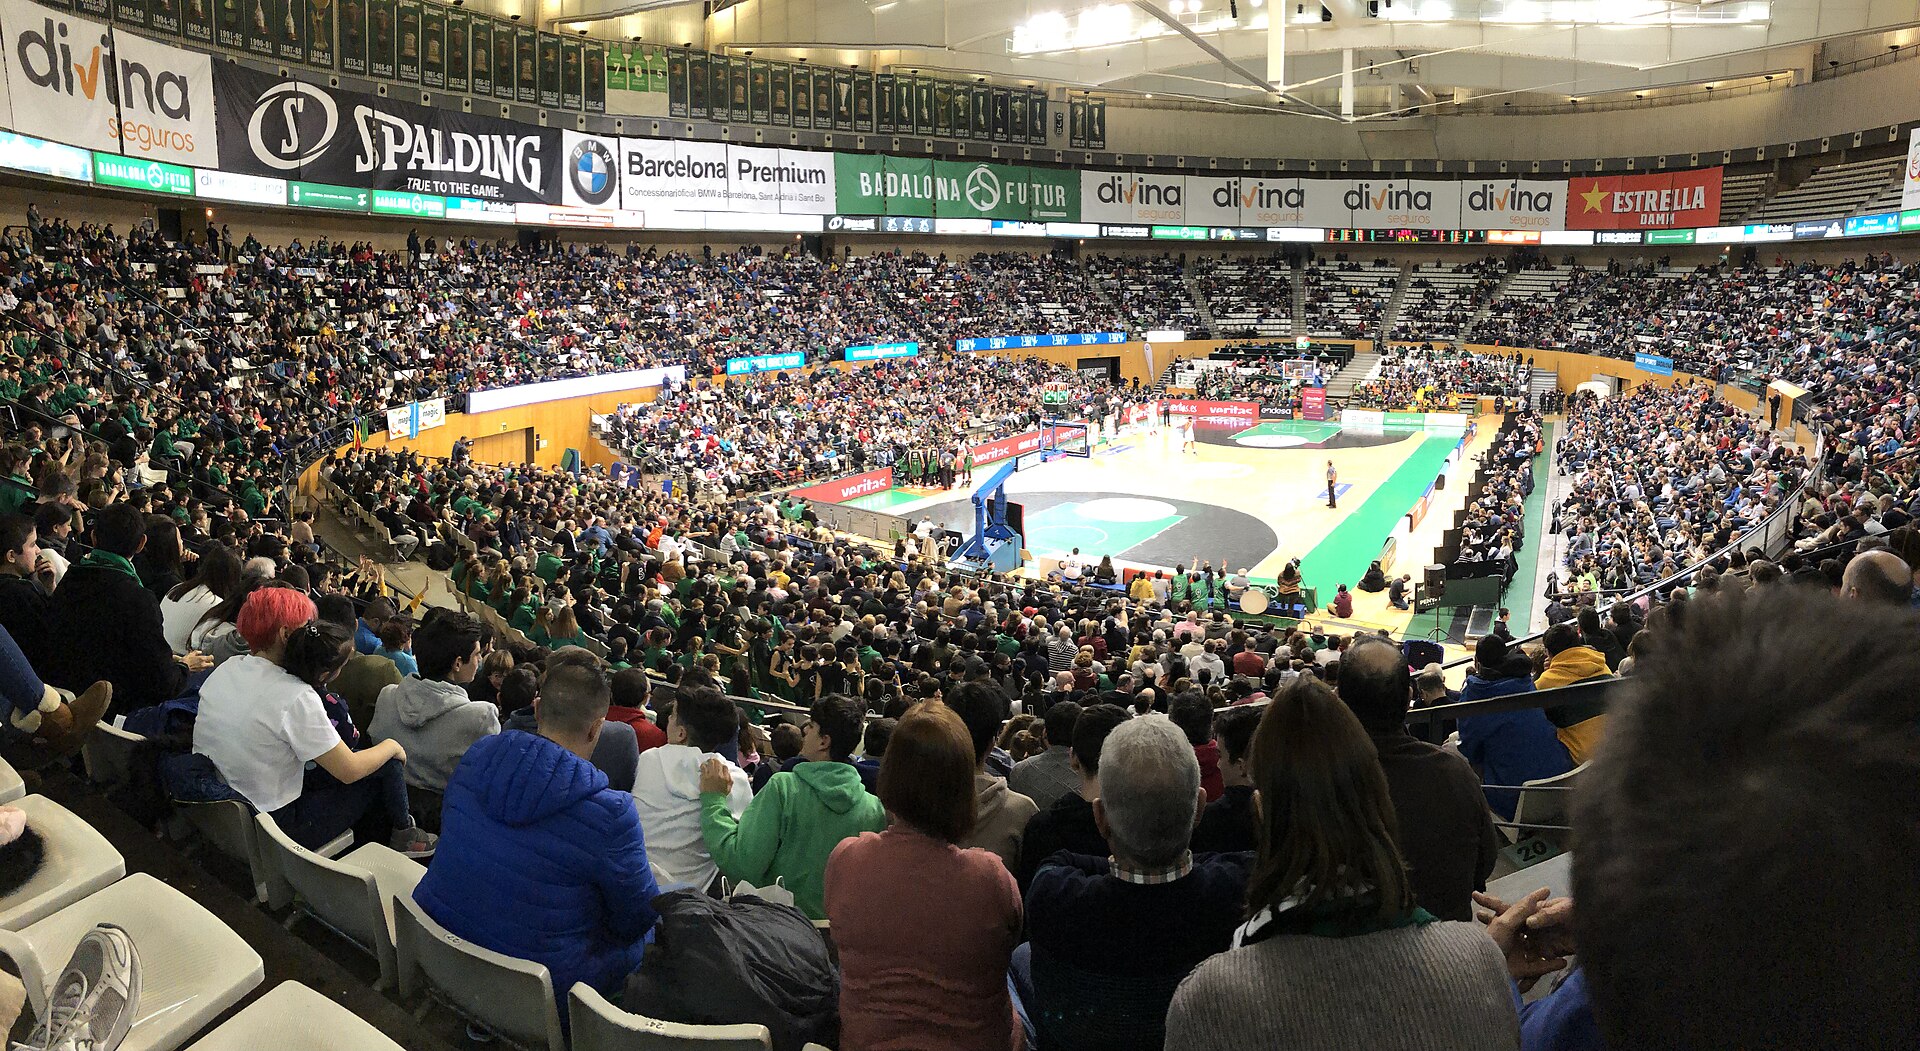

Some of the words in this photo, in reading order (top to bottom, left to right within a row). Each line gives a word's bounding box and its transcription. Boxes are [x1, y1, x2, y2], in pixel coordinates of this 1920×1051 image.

[17, 17, 191, 122] divina
[613, 63, 621, 76] 7
[634, 64, 643, 78] 8
[657, 69, 663, 79] 5
[107, 116, 195, 153] seguros
[353, 104, 542, 194] SPALDING
[573, 140, 613, 164] BMW
[98, 161, 146, 182] BADALONA
[165, 173, 190, 188] FUTUR
[628, 151, 727, 179] Barcelona
[738, 158, 826, 185] Premium
[407, 177, 431, 193] TRUE
[431, 179, 447, 193] TO
[449, 180, 471, 195] THE
[471, 184, 499, 197] GAME
[698, 188, 716, 198] BMW
[860, 172, 961, 202] BADALONA
[1006, 182, 1067, 207] FUTUR
[1097, 176, 1181, 206] divina
[1212, 180, 1305, 210] divina
[1343, 182, 1432, 211] divina
[1468, 183, 1552, 212] divina
[1612, 185, 1705, 215] ESTRELLA
[1137, 208, 1181, 222] seguros
[1257, 210, 1305, 224] seguros
[1387, 212, 1431, 227] seguros
[1509, 213, 1550, 227] seguros
[1640, 211, 1675, 227] DAMM
[1209, 405, 1253, 415] veritas
[1260, 406, 1291, 415] endesa
[973, 445, 1010, 463] veritas
[841, 475, 887, 498] veritas
[1517, 840, 1547, 862] 20
